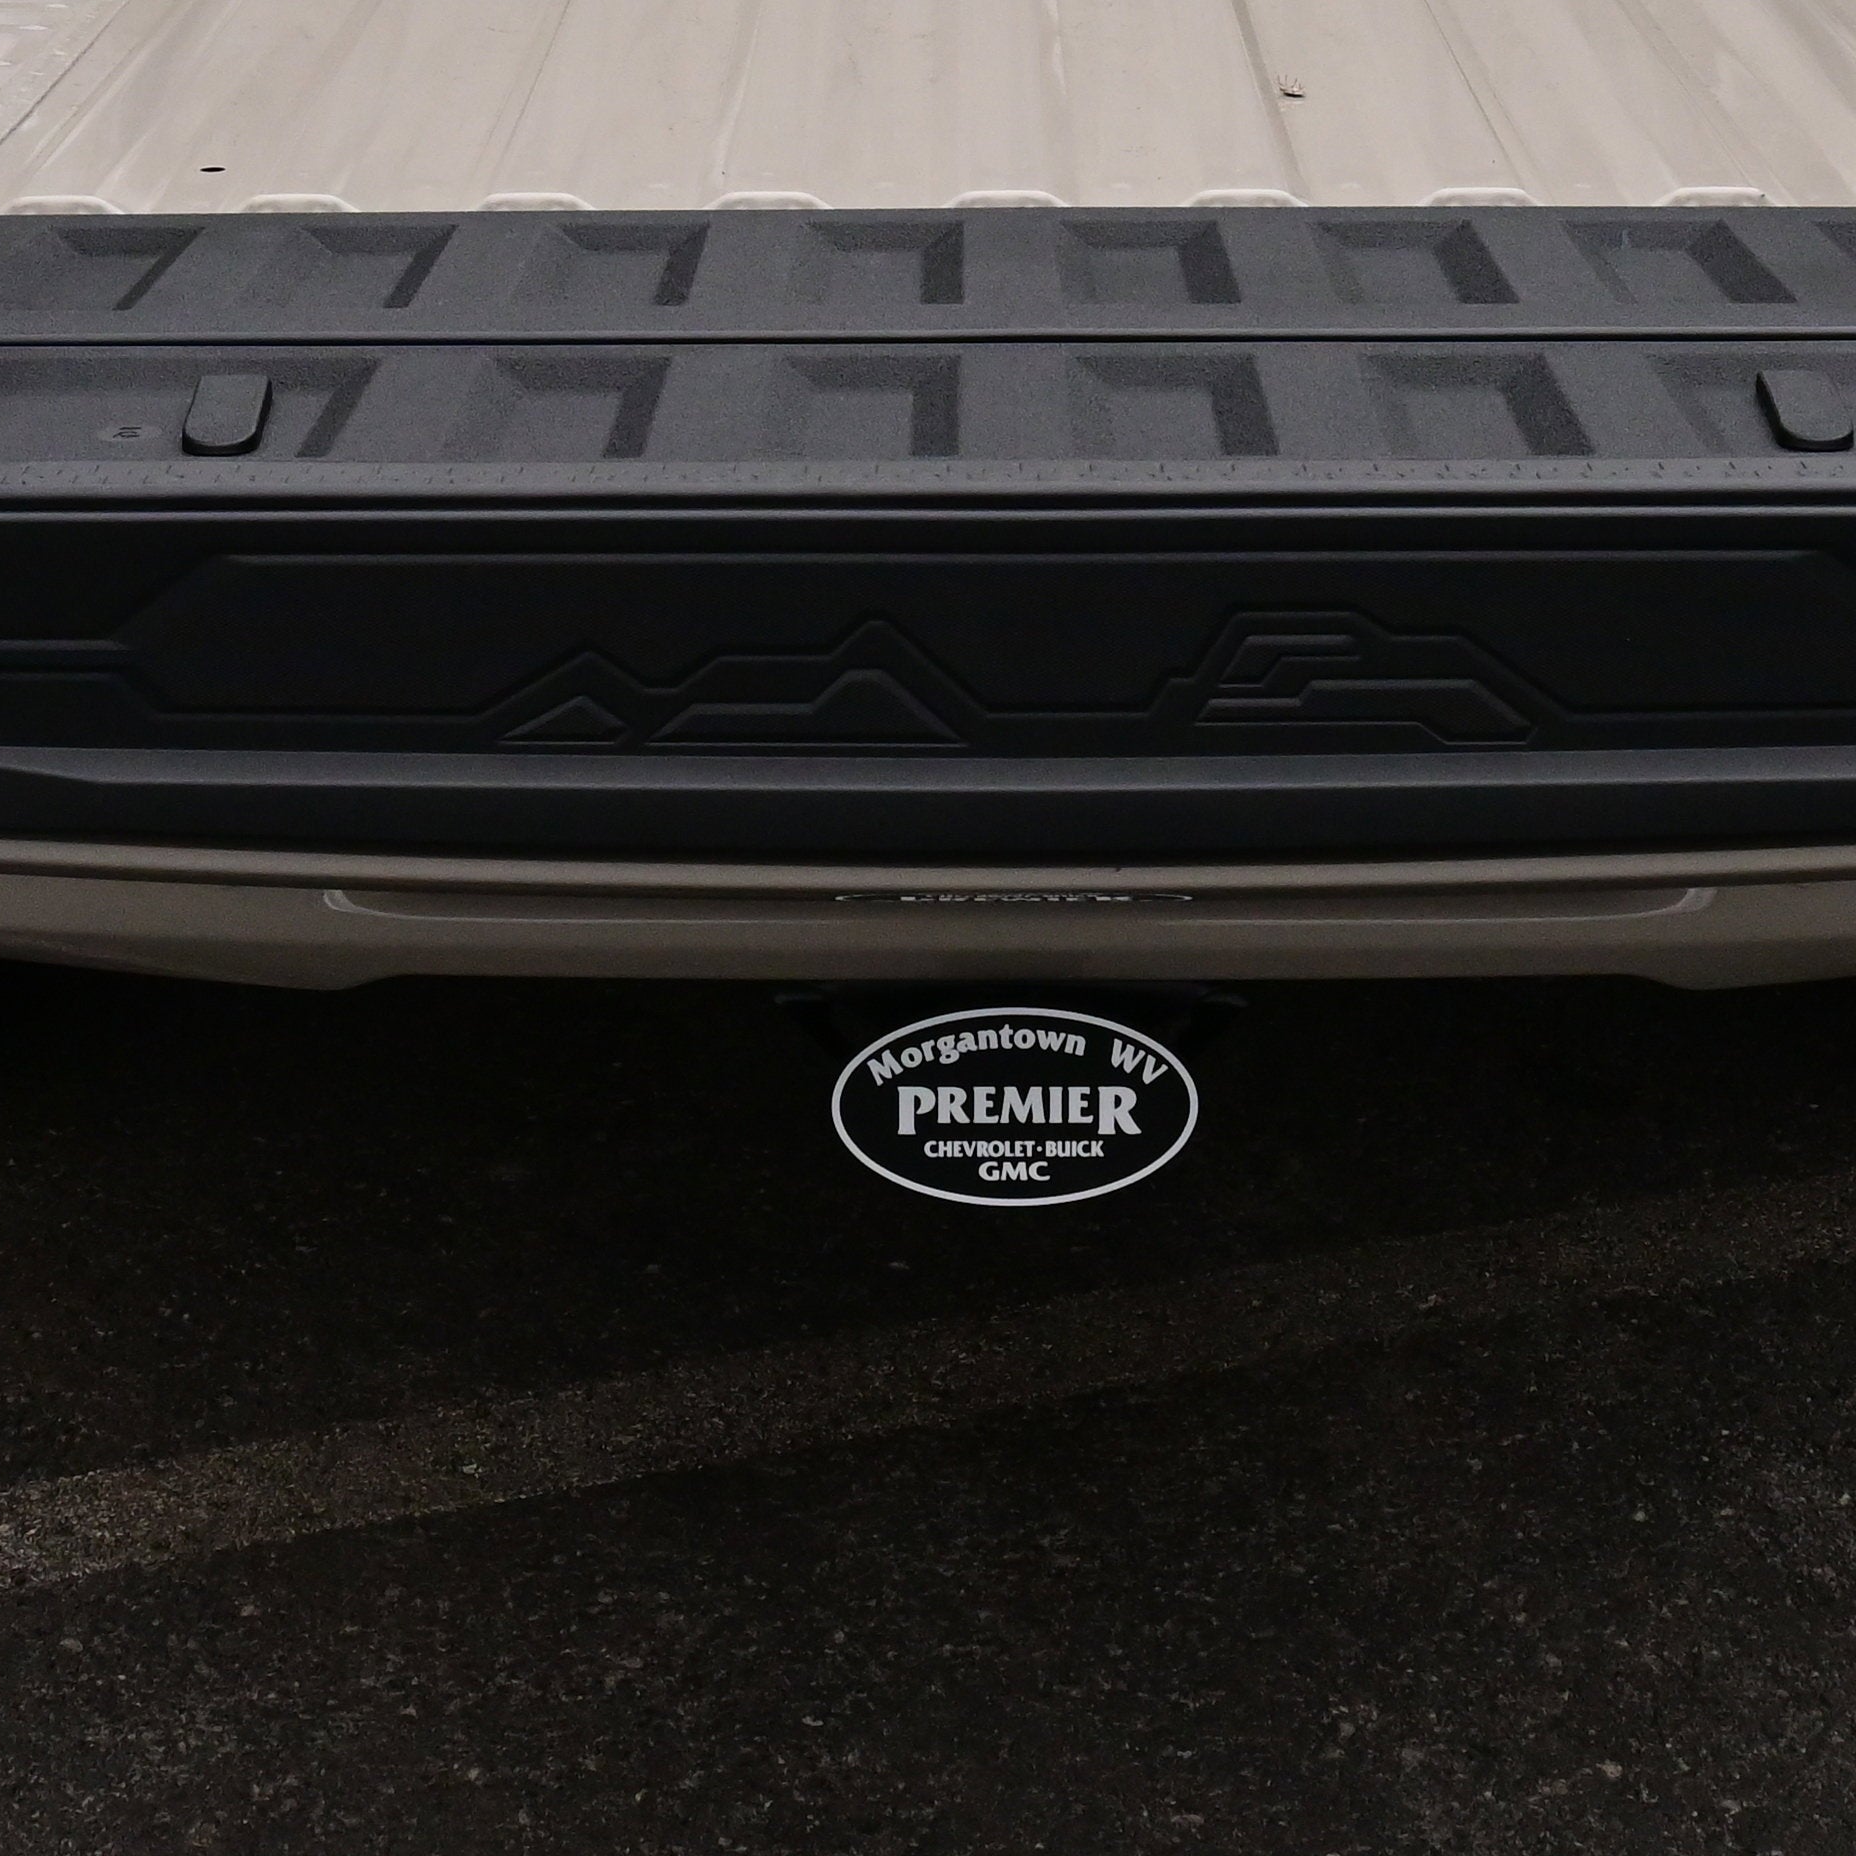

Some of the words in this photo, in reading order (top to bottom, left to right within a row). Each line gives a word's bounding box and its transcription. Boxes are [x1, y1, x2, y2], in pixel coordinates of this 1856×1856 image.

[866, 1024, 1086, 1086] Morgantown
[1111, 1038, 1169, 1085] WV
[897, 1086, 1142, 1135] PREMIER
[978, 1161, 1051, 1181] GMC
